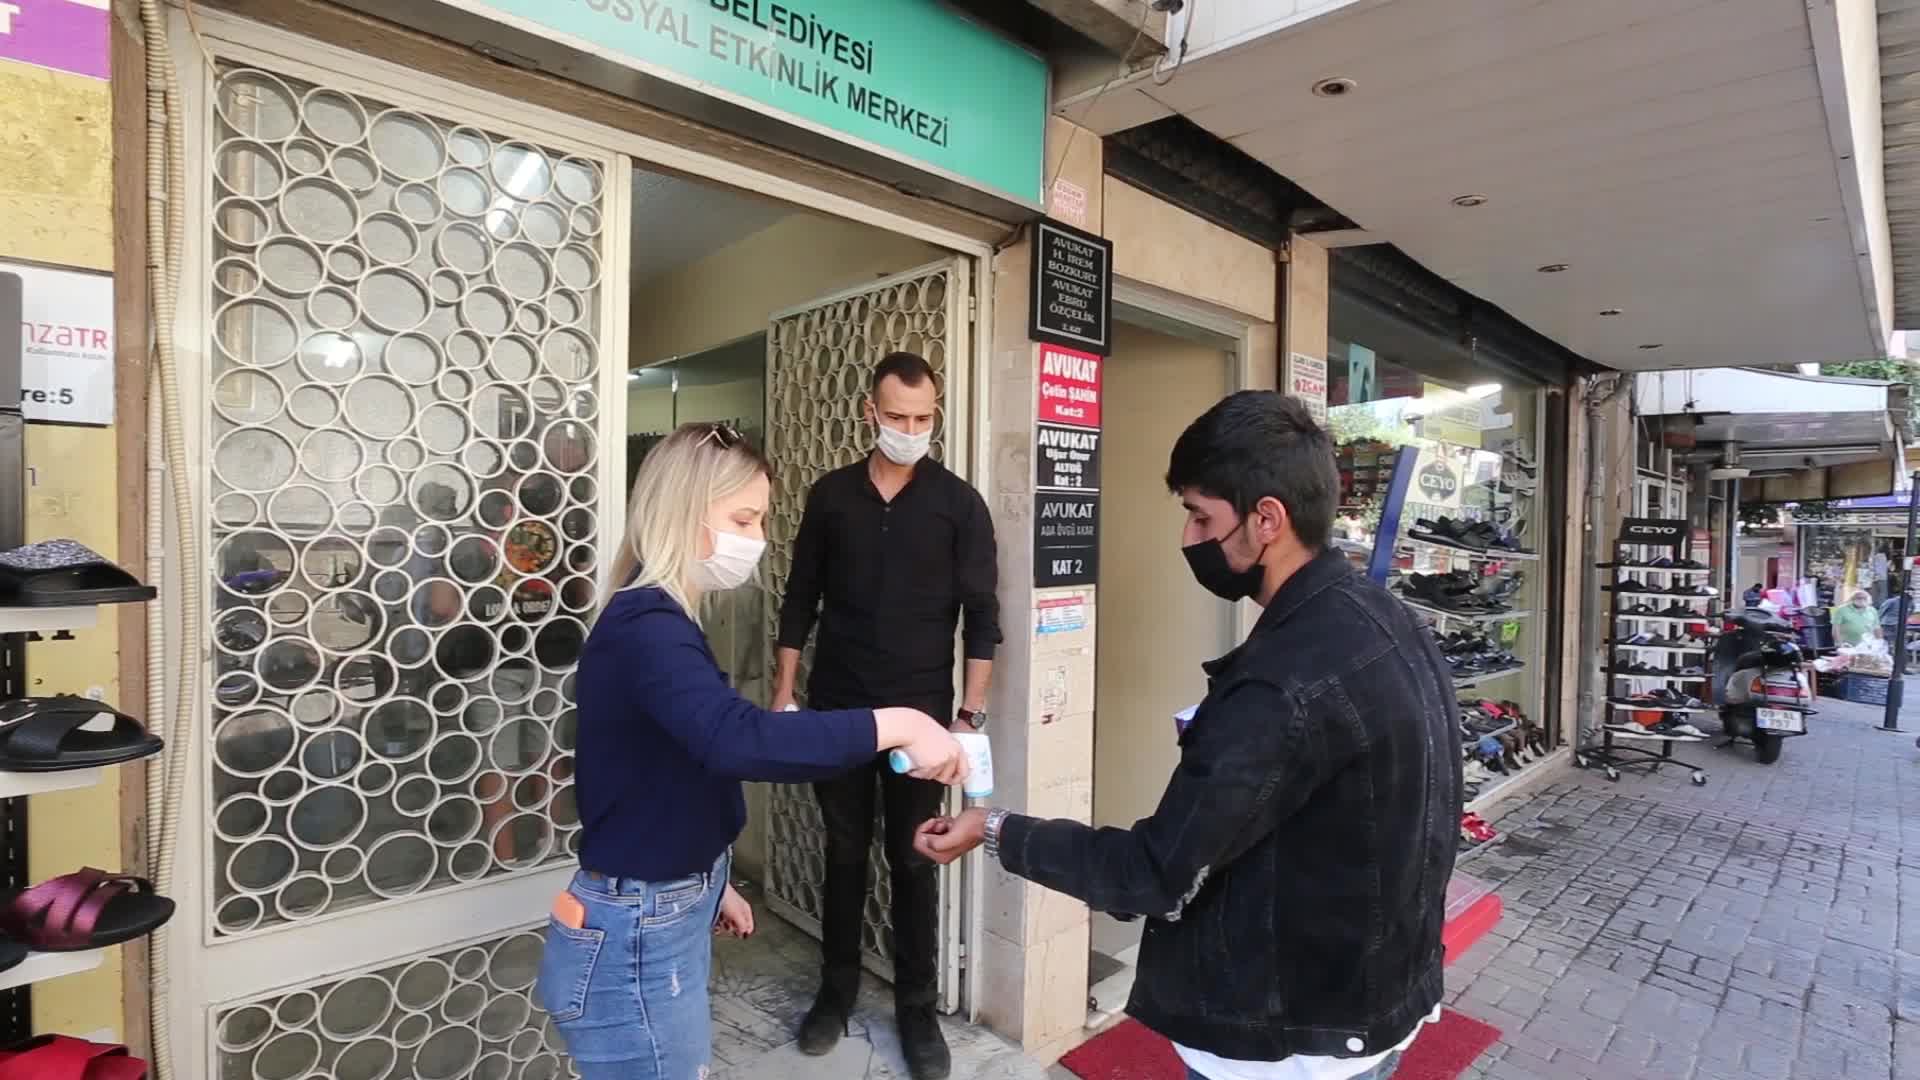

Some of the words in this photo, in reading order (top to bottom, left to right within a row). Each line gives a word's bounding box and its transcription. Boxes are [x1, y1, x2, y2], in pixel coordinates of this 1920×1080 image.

[709, 24, 839, 104] ETKİNLİK
[847, 81, 948, 148] MERKEZİ
[1052, 236, 1095, 259] AVUKAT
[1048, 260, 1097, 283] BOZKURT
[1052, 279, 1094, 299] AVUKAT
[1043, 351, 1097, 383] AVUKAT
[1039, 429, 1098, 450] AVUKAT
[1041, 502, 1094, 519] AVUKAT
[1630, 526, 1677, 534] CEYO
[1052, 559, 1073, 576] KAT
[1075, 558, 1083, 574] 2
